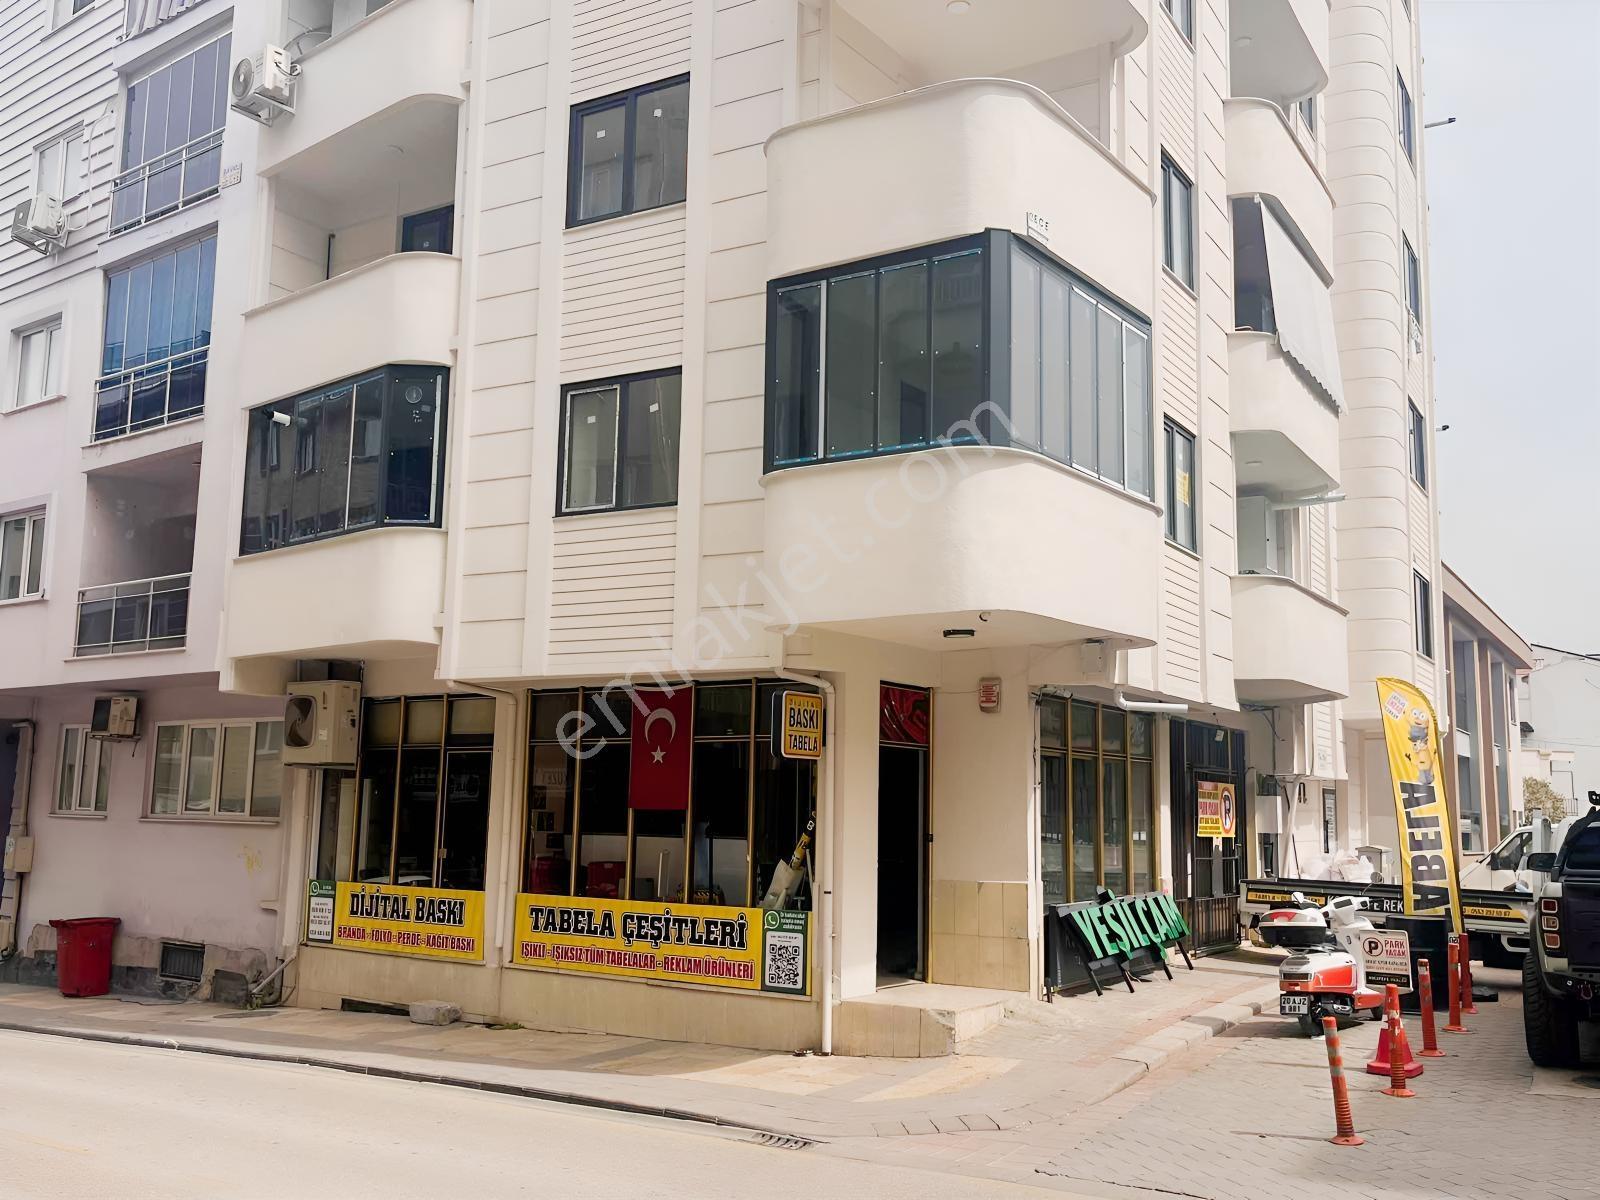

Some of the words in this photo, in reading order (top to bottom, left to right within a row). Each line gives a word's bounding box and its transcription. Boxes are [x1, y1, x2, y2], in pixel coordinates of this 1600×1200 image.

[789, 708, 819, 730] BASKI
[788, 734, 818, 752] TABELA
[349, 885, 411, 921] DİJİTAL
[414, 897, 465, 927] BASKI
[1383, 899, 1404, 913] REK
[528, 905, 616, 938] TABELA
[621, 908, 747, 949] ÇEŞİTLERİ
[337, 925, 366, 941] BRANDA
[397, 931, 421, 947] PERDE
[450, 936, 475, 952] BASKI
[1384, 939, 1405, 950] PARK
[584, 944, 604, 964] TÜM
[605, 949, 656, 971] TABELALAR
[663, 955, 701, 976] REKLAM
[703, 955, 755, 980] ÜRÜNLERİ
[1282, 997, 1291, 1005] 20
